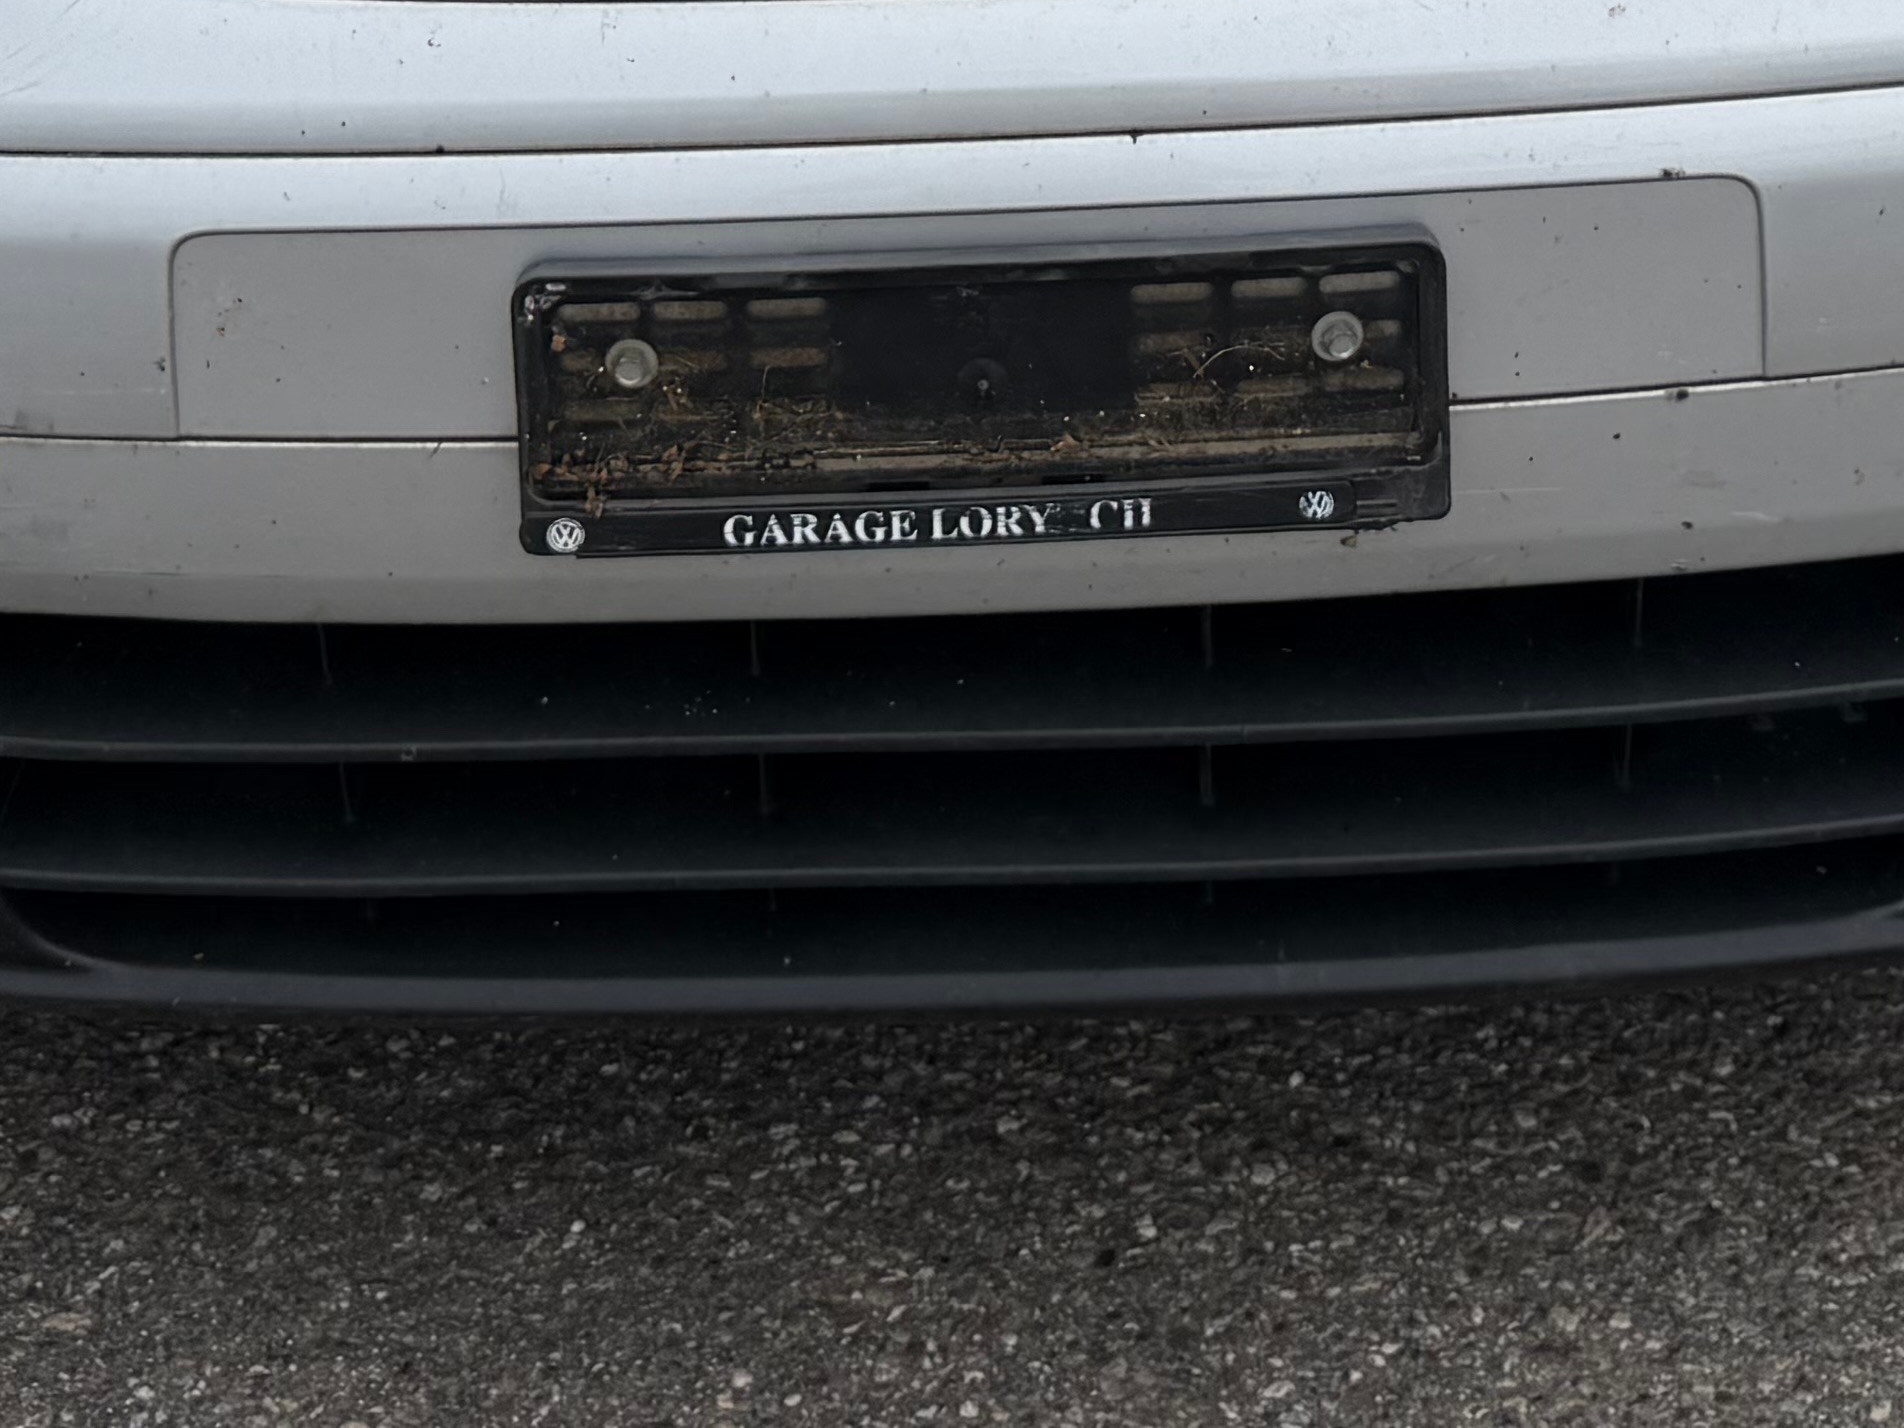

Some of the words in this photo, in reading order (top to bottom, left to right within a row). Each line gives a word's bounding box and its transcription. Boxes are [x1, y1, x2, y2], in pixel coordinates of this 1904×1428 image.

[546, 517, 586, 553] VW
[723, 509, 918, 546] GARAGE
[931, 502, 1062, 540] LORY
